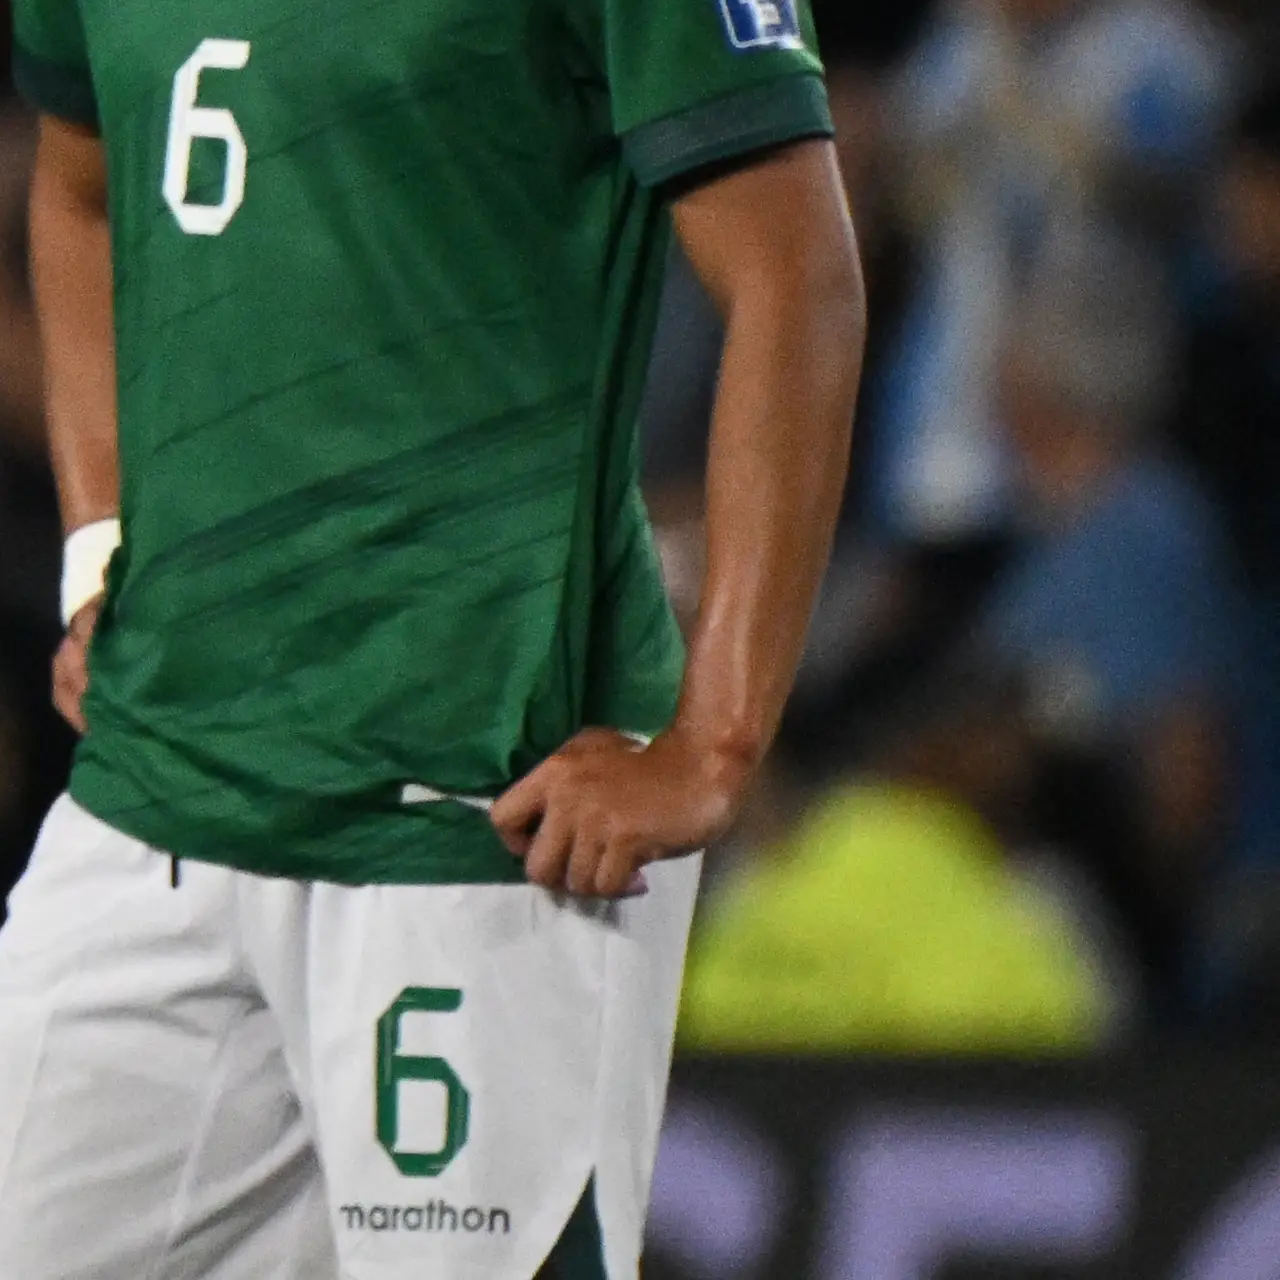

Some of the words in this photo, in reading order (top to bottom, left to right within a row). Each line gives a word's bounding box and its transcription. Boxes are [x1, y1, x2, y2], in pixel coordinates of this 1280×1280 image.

[162, 38, 251, 236] 6
[375, 985, 471, 1177] 6
[340, 1199, 511, 1234] marathon
